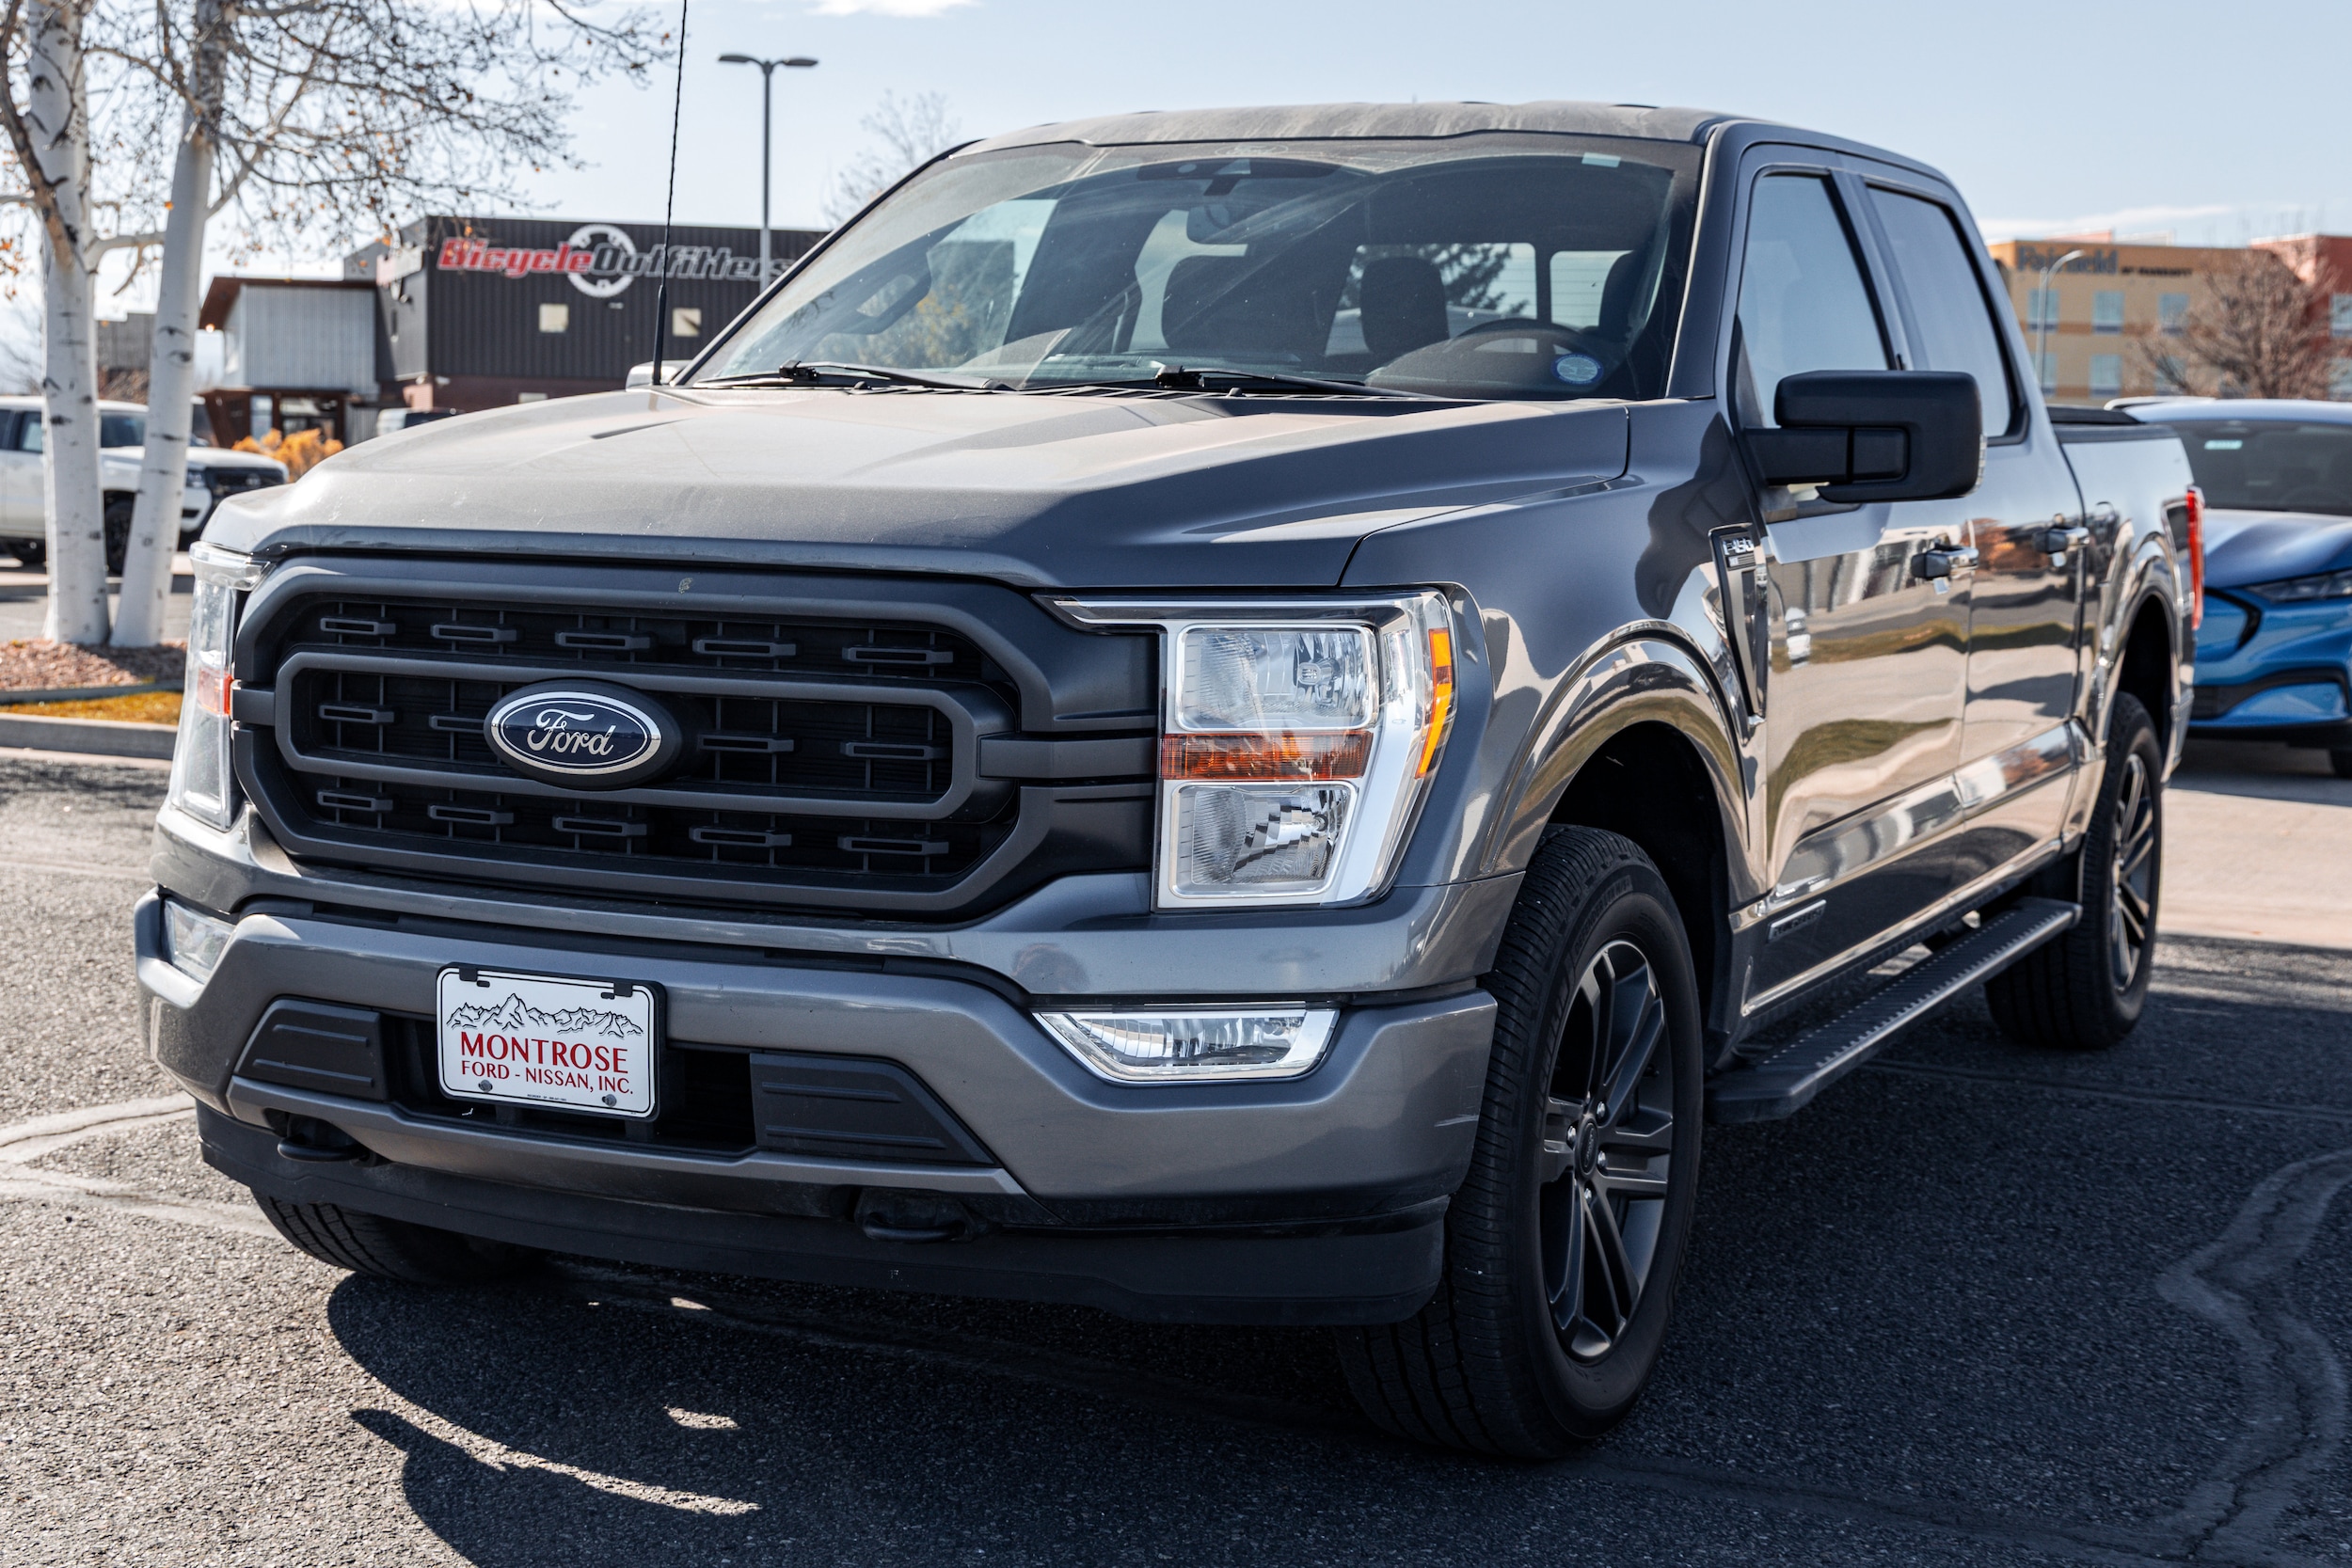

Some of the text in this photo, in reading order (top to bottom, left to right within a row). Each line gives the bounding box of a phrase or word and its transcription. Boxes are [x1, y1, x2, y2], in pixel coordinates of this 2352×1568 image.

[437, 237, 594, 277] Bicycle
[527, 708, 617, 756] Ford
[460, 1031, 629, 1074] MONTROSE
[461, 1060, 510, 1080] FORD
[525, 1067, 594, 1093] NISSAN,
[598, 1075, 633, 1095] INC.
